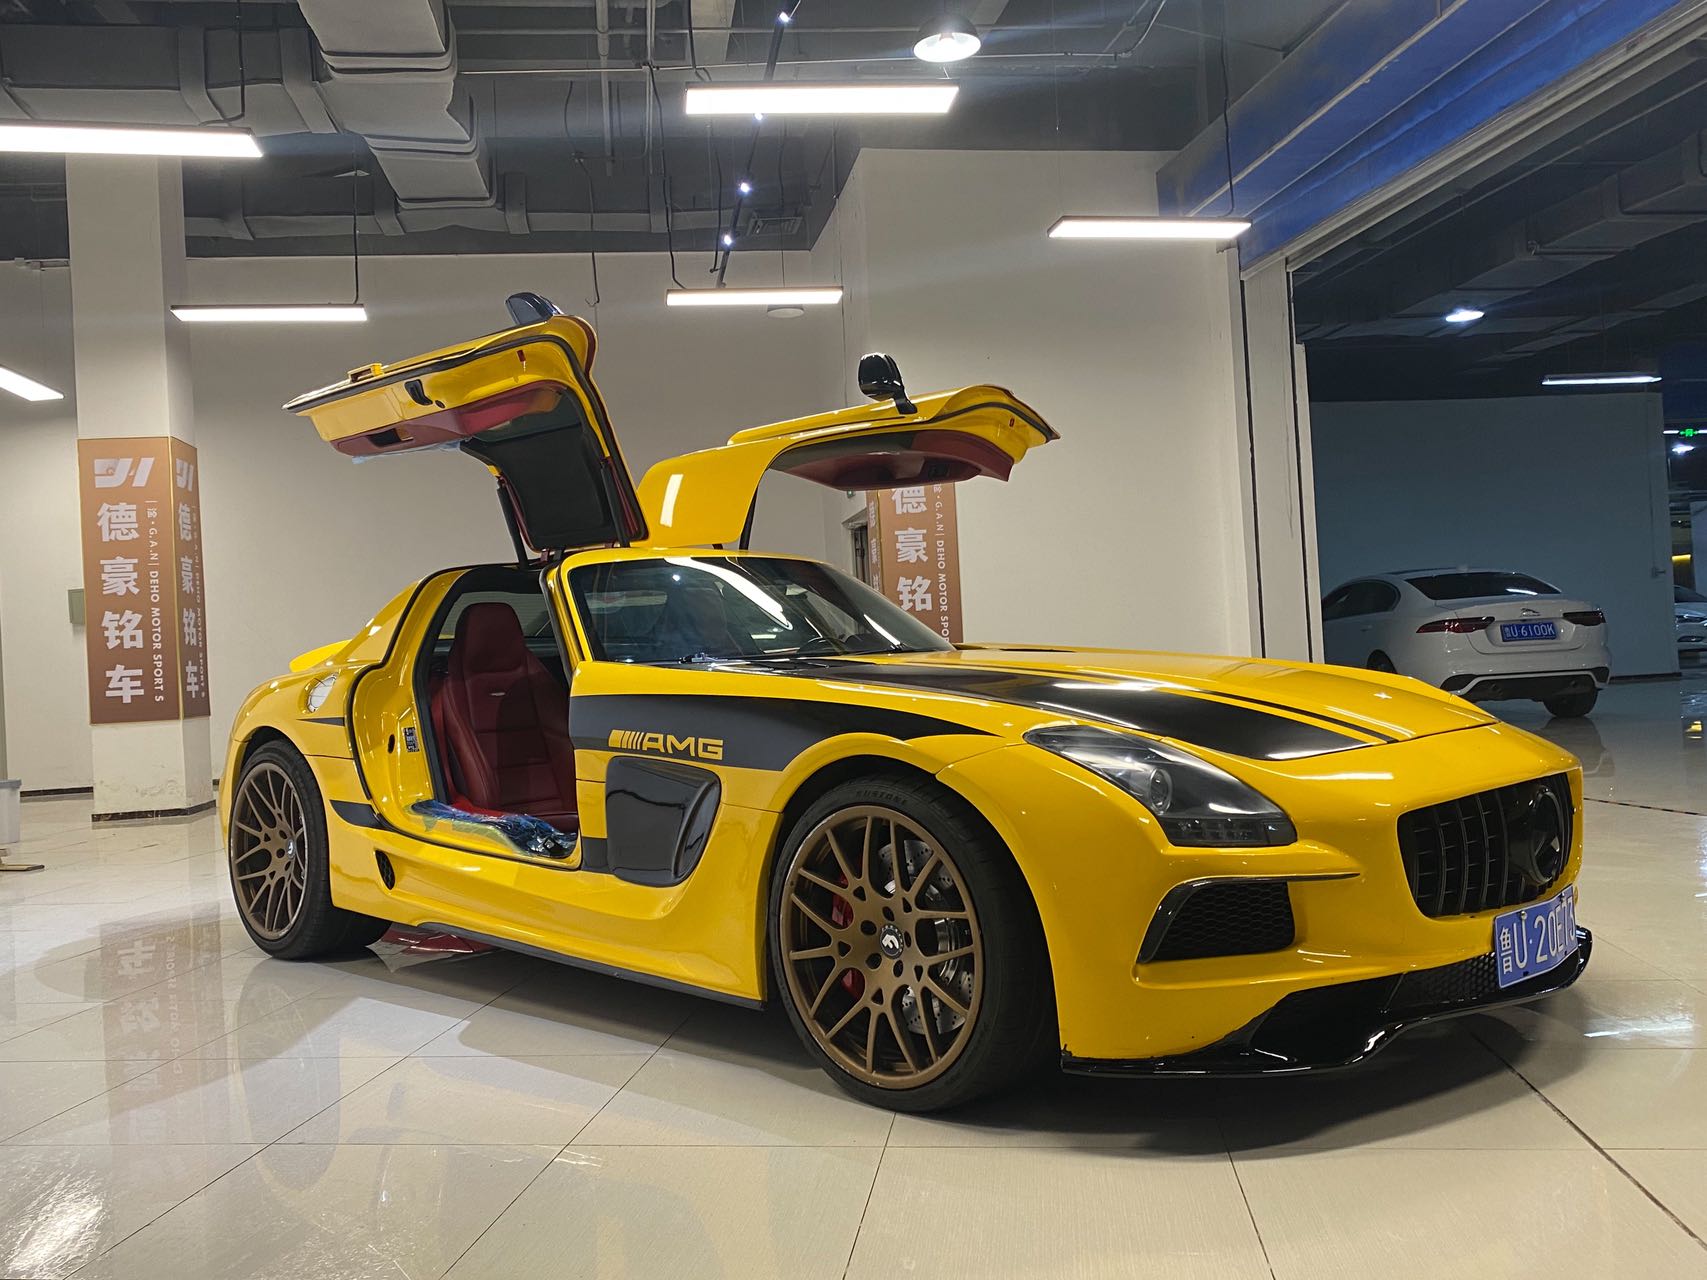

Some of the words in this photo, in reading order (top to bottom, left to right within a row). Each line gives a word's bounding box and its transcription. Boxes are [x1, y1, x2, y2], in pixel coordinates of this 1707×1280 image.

[936, 540, 946, 569] DEHO
[97, 502, 144, 704] 德豪铭车
[149, 570, 160, 603] DEHO
[938, 574, 948, 612] MOTOR
[151, 607, 162, 650] MOTOR
[642, 732, 723, 760] AMG
